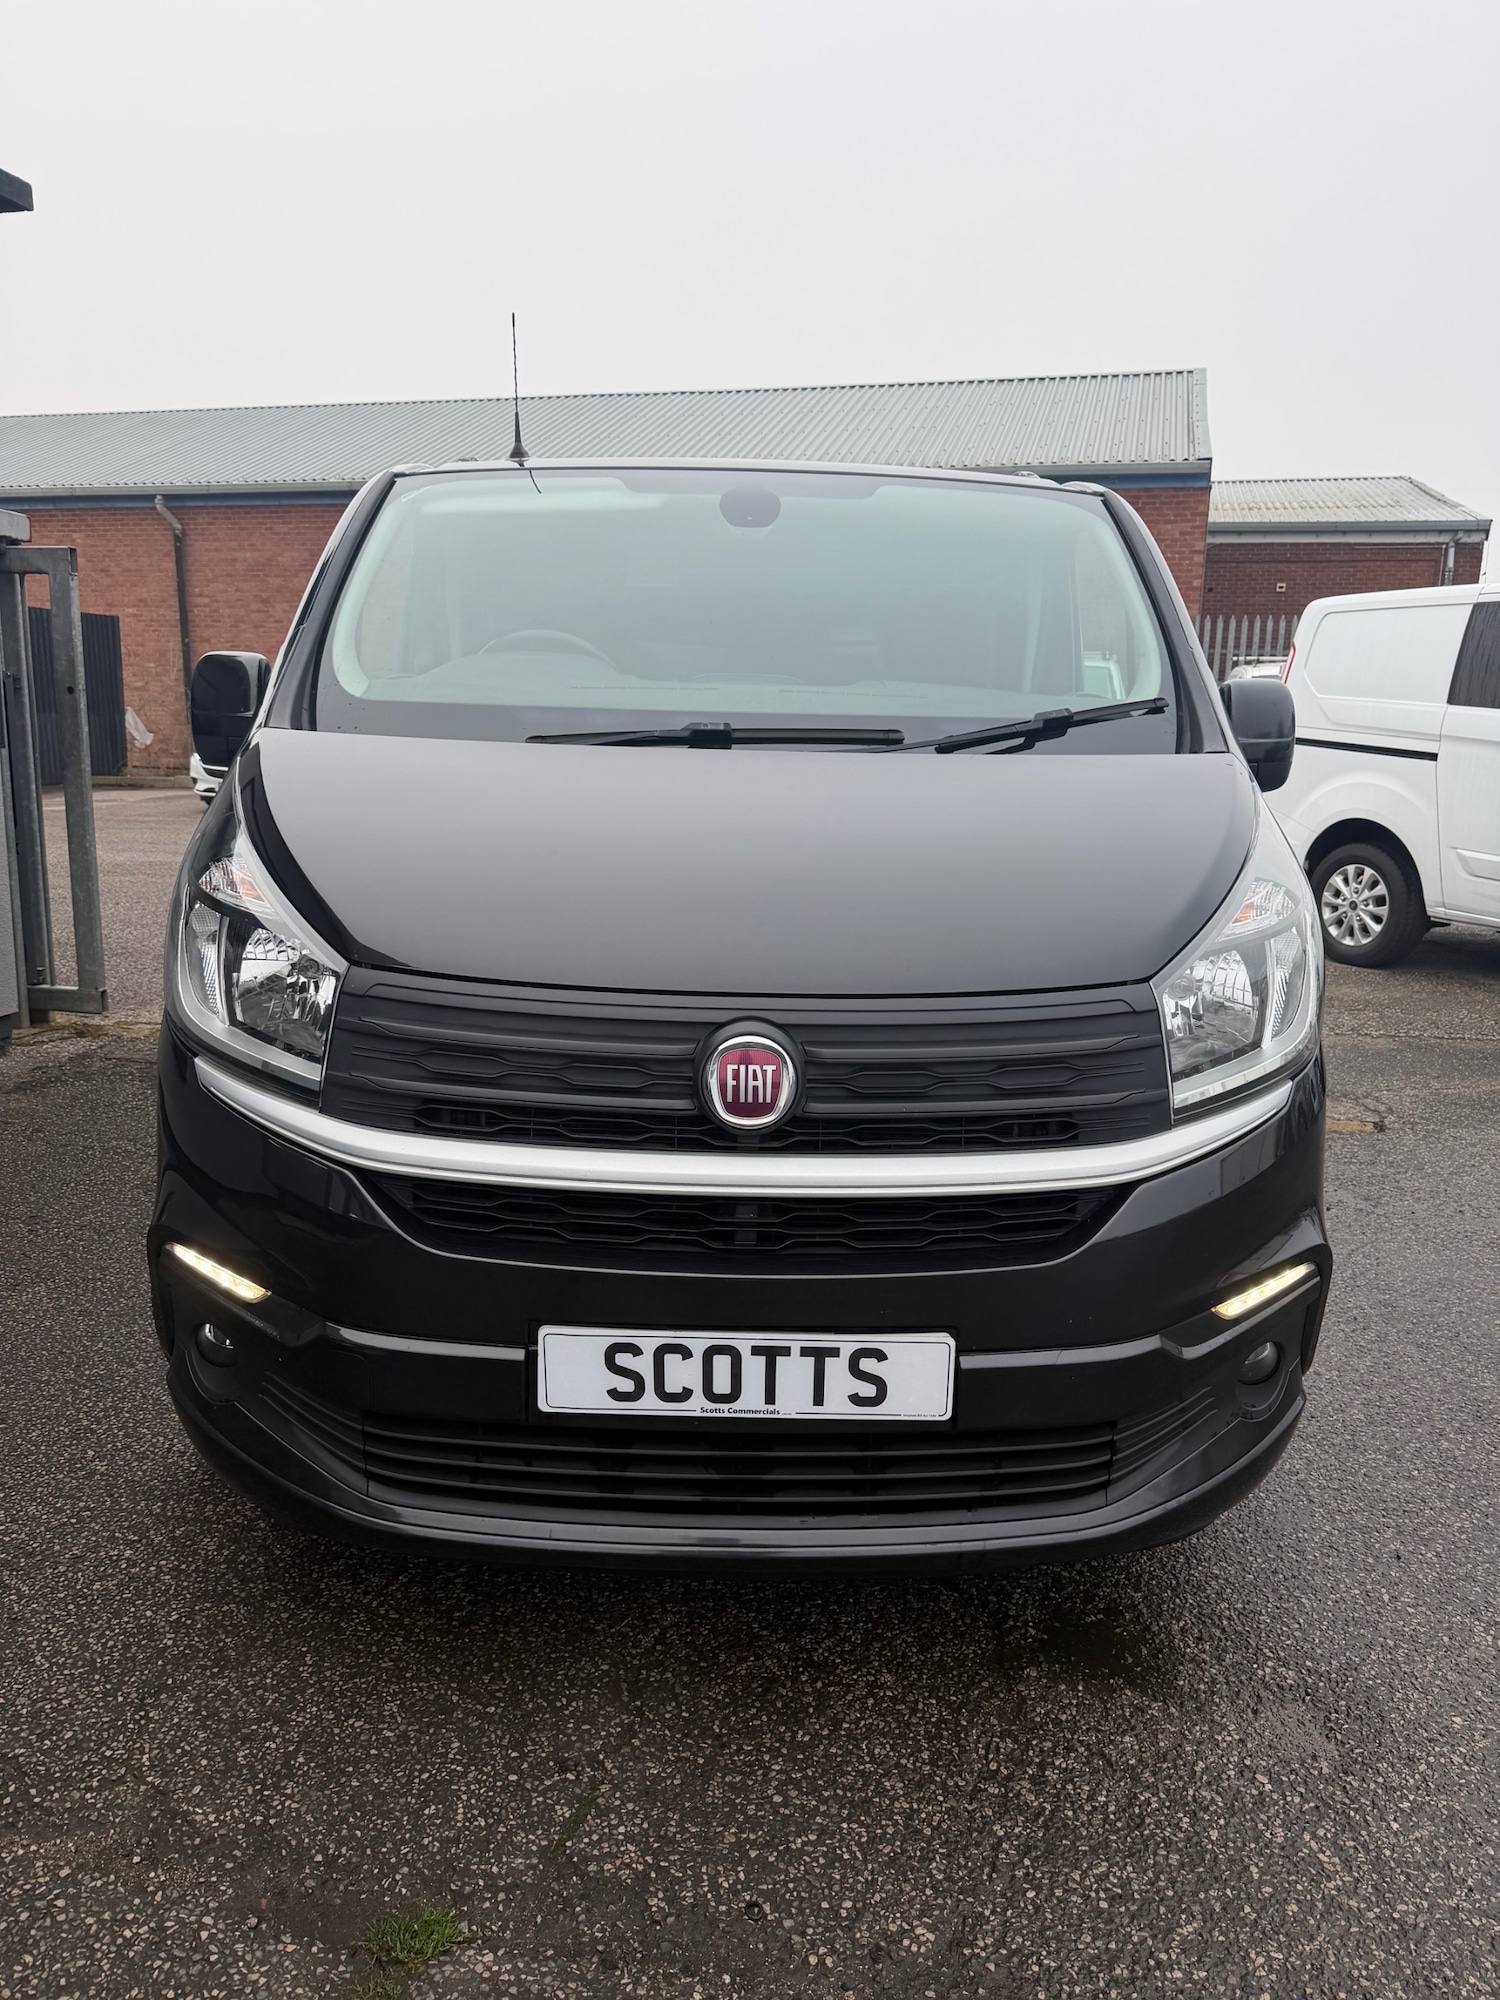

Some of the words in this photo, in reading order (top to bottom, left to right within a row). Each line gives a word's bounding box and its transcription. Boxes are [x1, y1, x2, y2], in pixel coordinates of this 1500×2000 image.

[726, 1064, 777, 1104] FIAT
[604, 1342, 889, 1407] SCOTTS
[727, 1407, 780, 1415] Commercials
